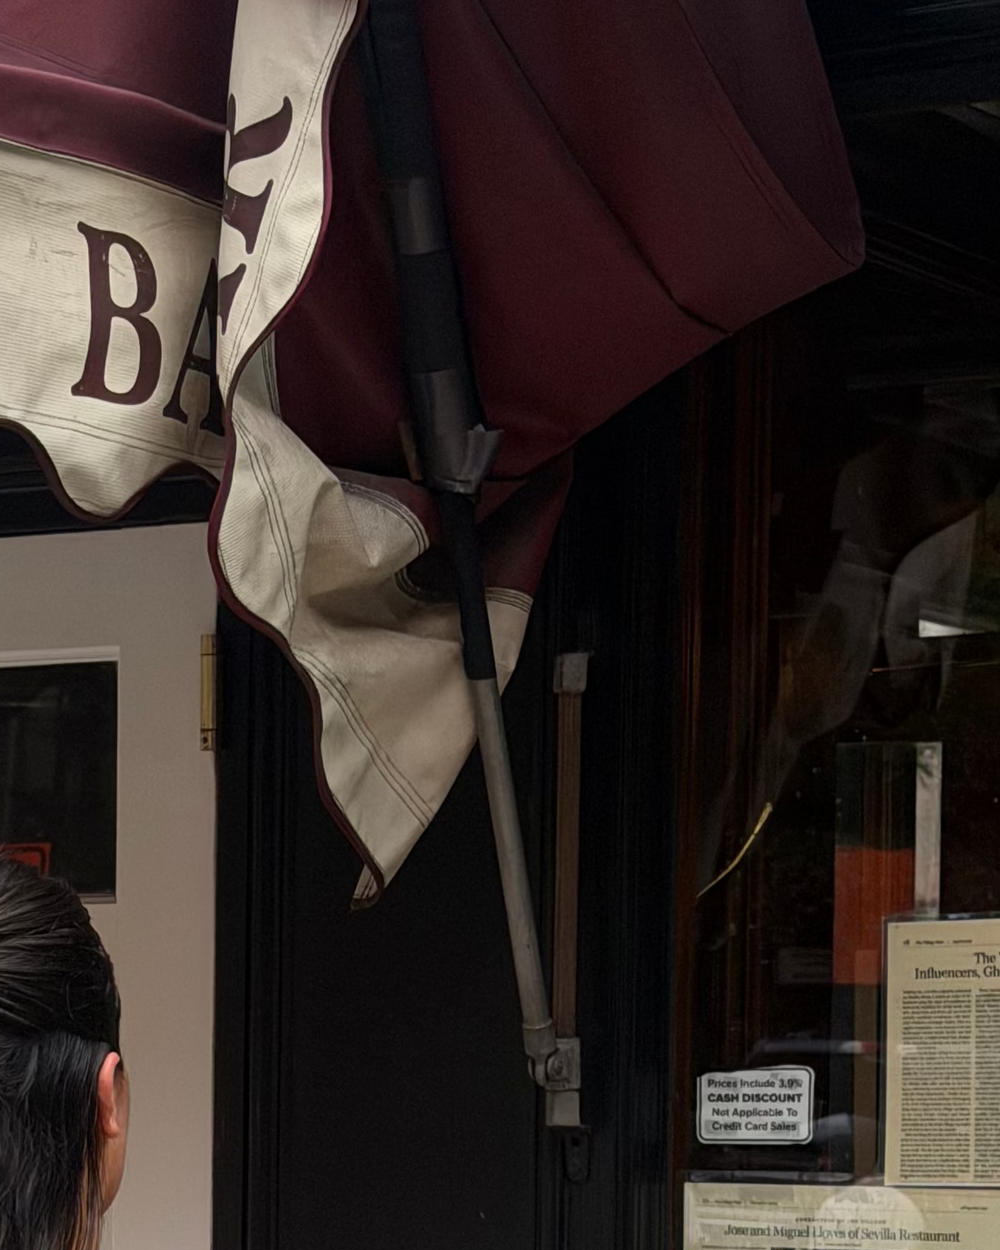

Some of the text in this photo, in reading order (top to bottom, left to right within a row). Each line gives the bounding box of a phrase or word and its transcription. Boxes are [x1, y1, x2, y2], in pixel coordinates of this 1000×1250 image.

[974, 952, 996, 964] The
[914, 966, 981, 980] Influencers,
[707, 1078, 738, 1088] Prices
[740, 1078, 776, 1088] Include
[707, 1093, 803, 1103] CASH DISCOUNT
[712, 1107, 798, 1118] Not Applicable To
[712, 1121, 797, 1131] Credit Card Sales
[749, 1225, 771, 1236] and
[772, 1225, 810, 1241] Miguel
[847, 1227, 860, 1239] of
[861, 1228, 897, 1241] Sevilla
[899, 1229, 961, 1243] Restaurant
